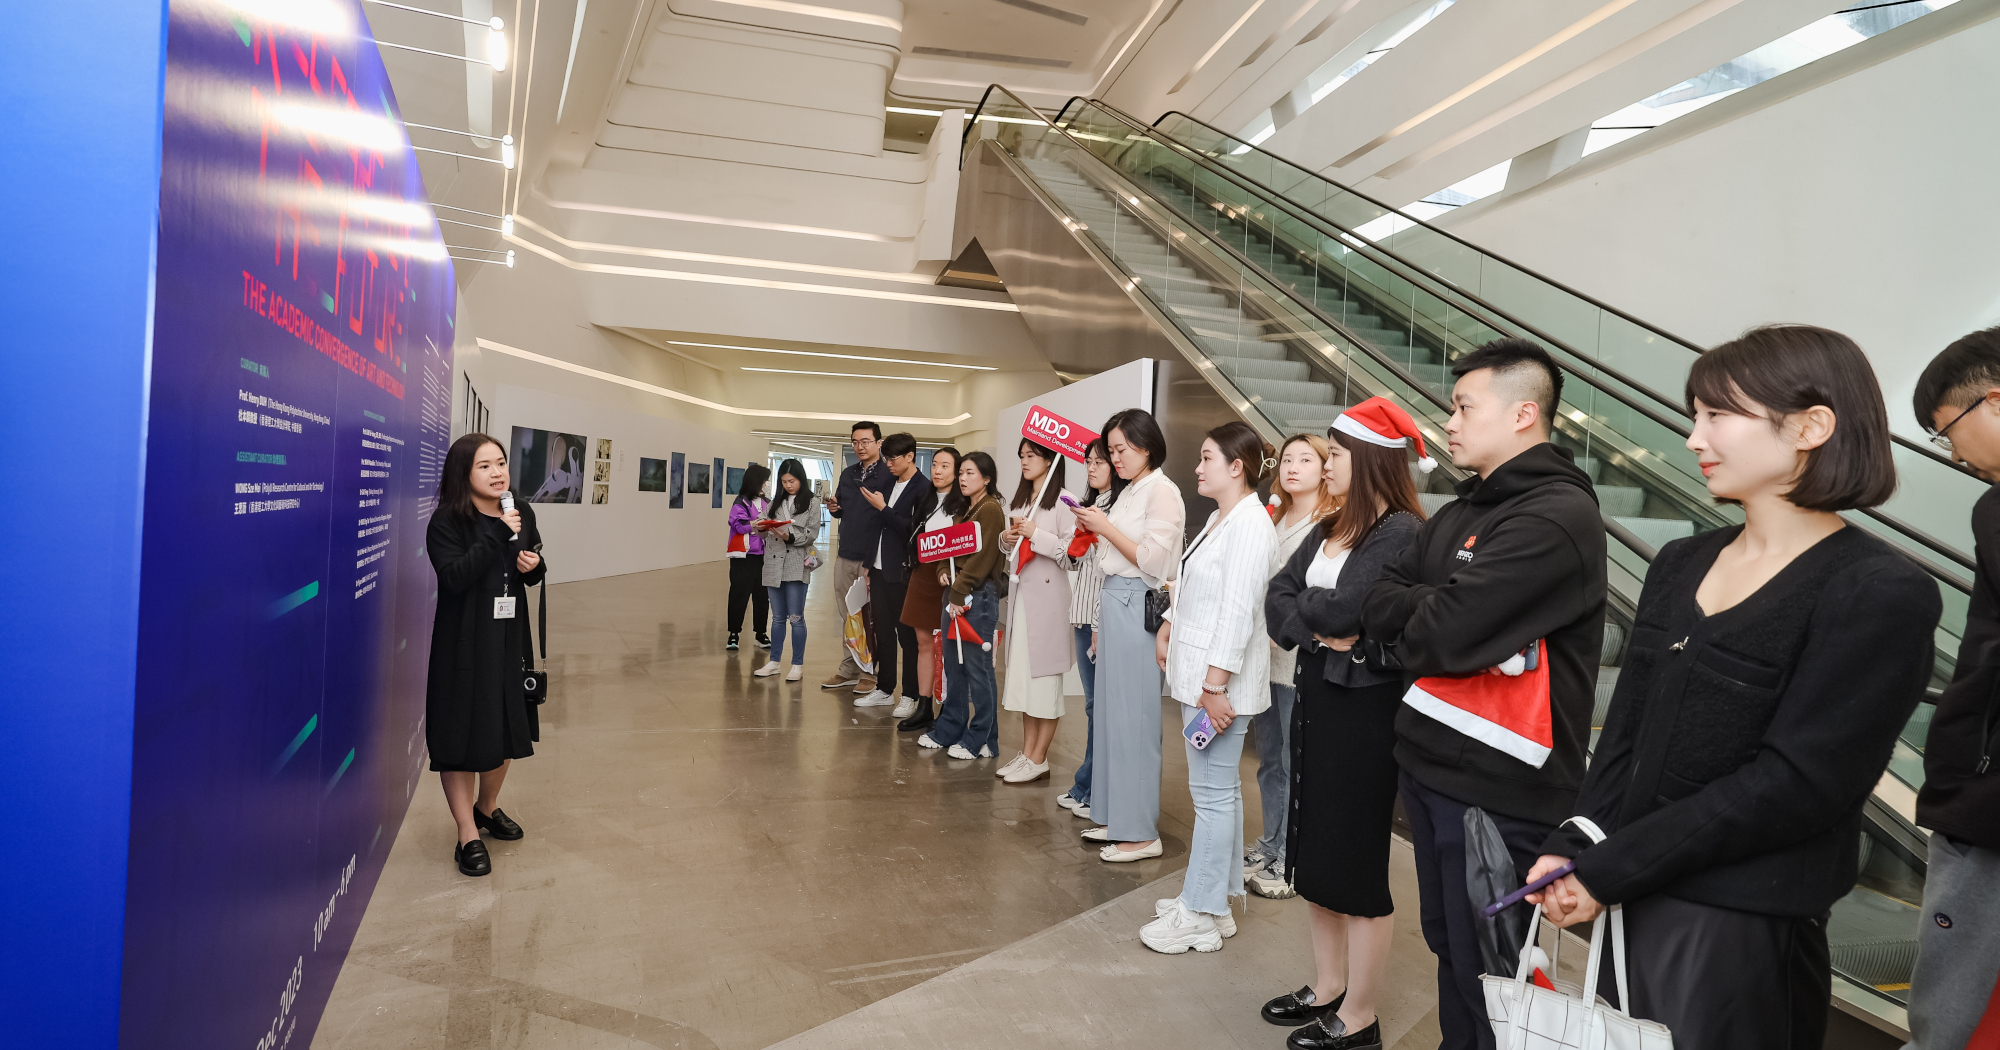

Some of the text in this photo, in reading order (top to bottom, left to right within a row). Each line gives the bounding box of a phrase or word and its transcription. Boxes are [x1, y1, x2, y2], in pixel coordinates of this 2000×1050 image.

[242, 269, 267, 318] THE
[268, 290, 315, 347] ACADEMIC
[315, 323, 360, 375] CONVERGENCE
[359, 355, 367, 378] OF
[366, 360, 377, 386] ART
[239, 388, 249, 402] Prof.
[248, 391, 260, 408] Henry
[1029, 410, 1071, 440] MDO
[1026, 426, 1086, 458] Mainland Developmen
[920, 533, 946, 552] MDO
[921, 541, 975, 558] Mainland Development Office
[279, 955, 303, 1032] 2023
